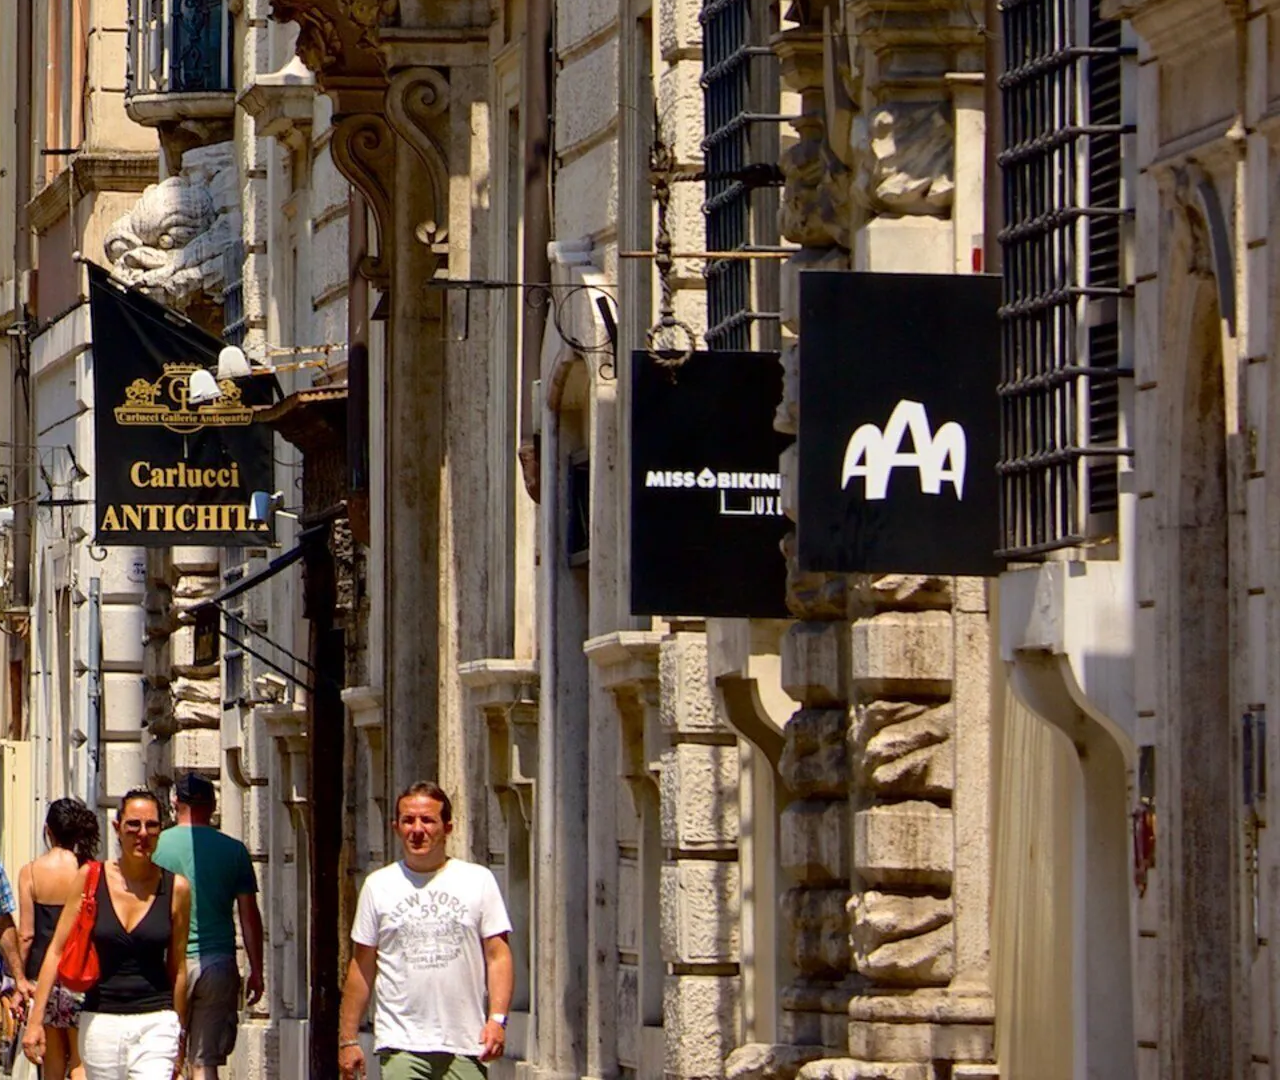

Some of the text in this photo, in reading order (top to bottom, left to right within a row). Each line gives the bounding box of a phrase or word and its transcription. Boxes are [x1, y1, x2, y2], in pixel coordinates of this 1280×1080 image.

[119, 411, 159, 422] Carlucci
[161, 411, 198, 423] Gallerie
[130, 461, 240, 488] Carlucci
[646, 471, 695, 488] MISS
[389, 890, 469, 923] NEW YORK
[421, 904, 439, 919] 59
